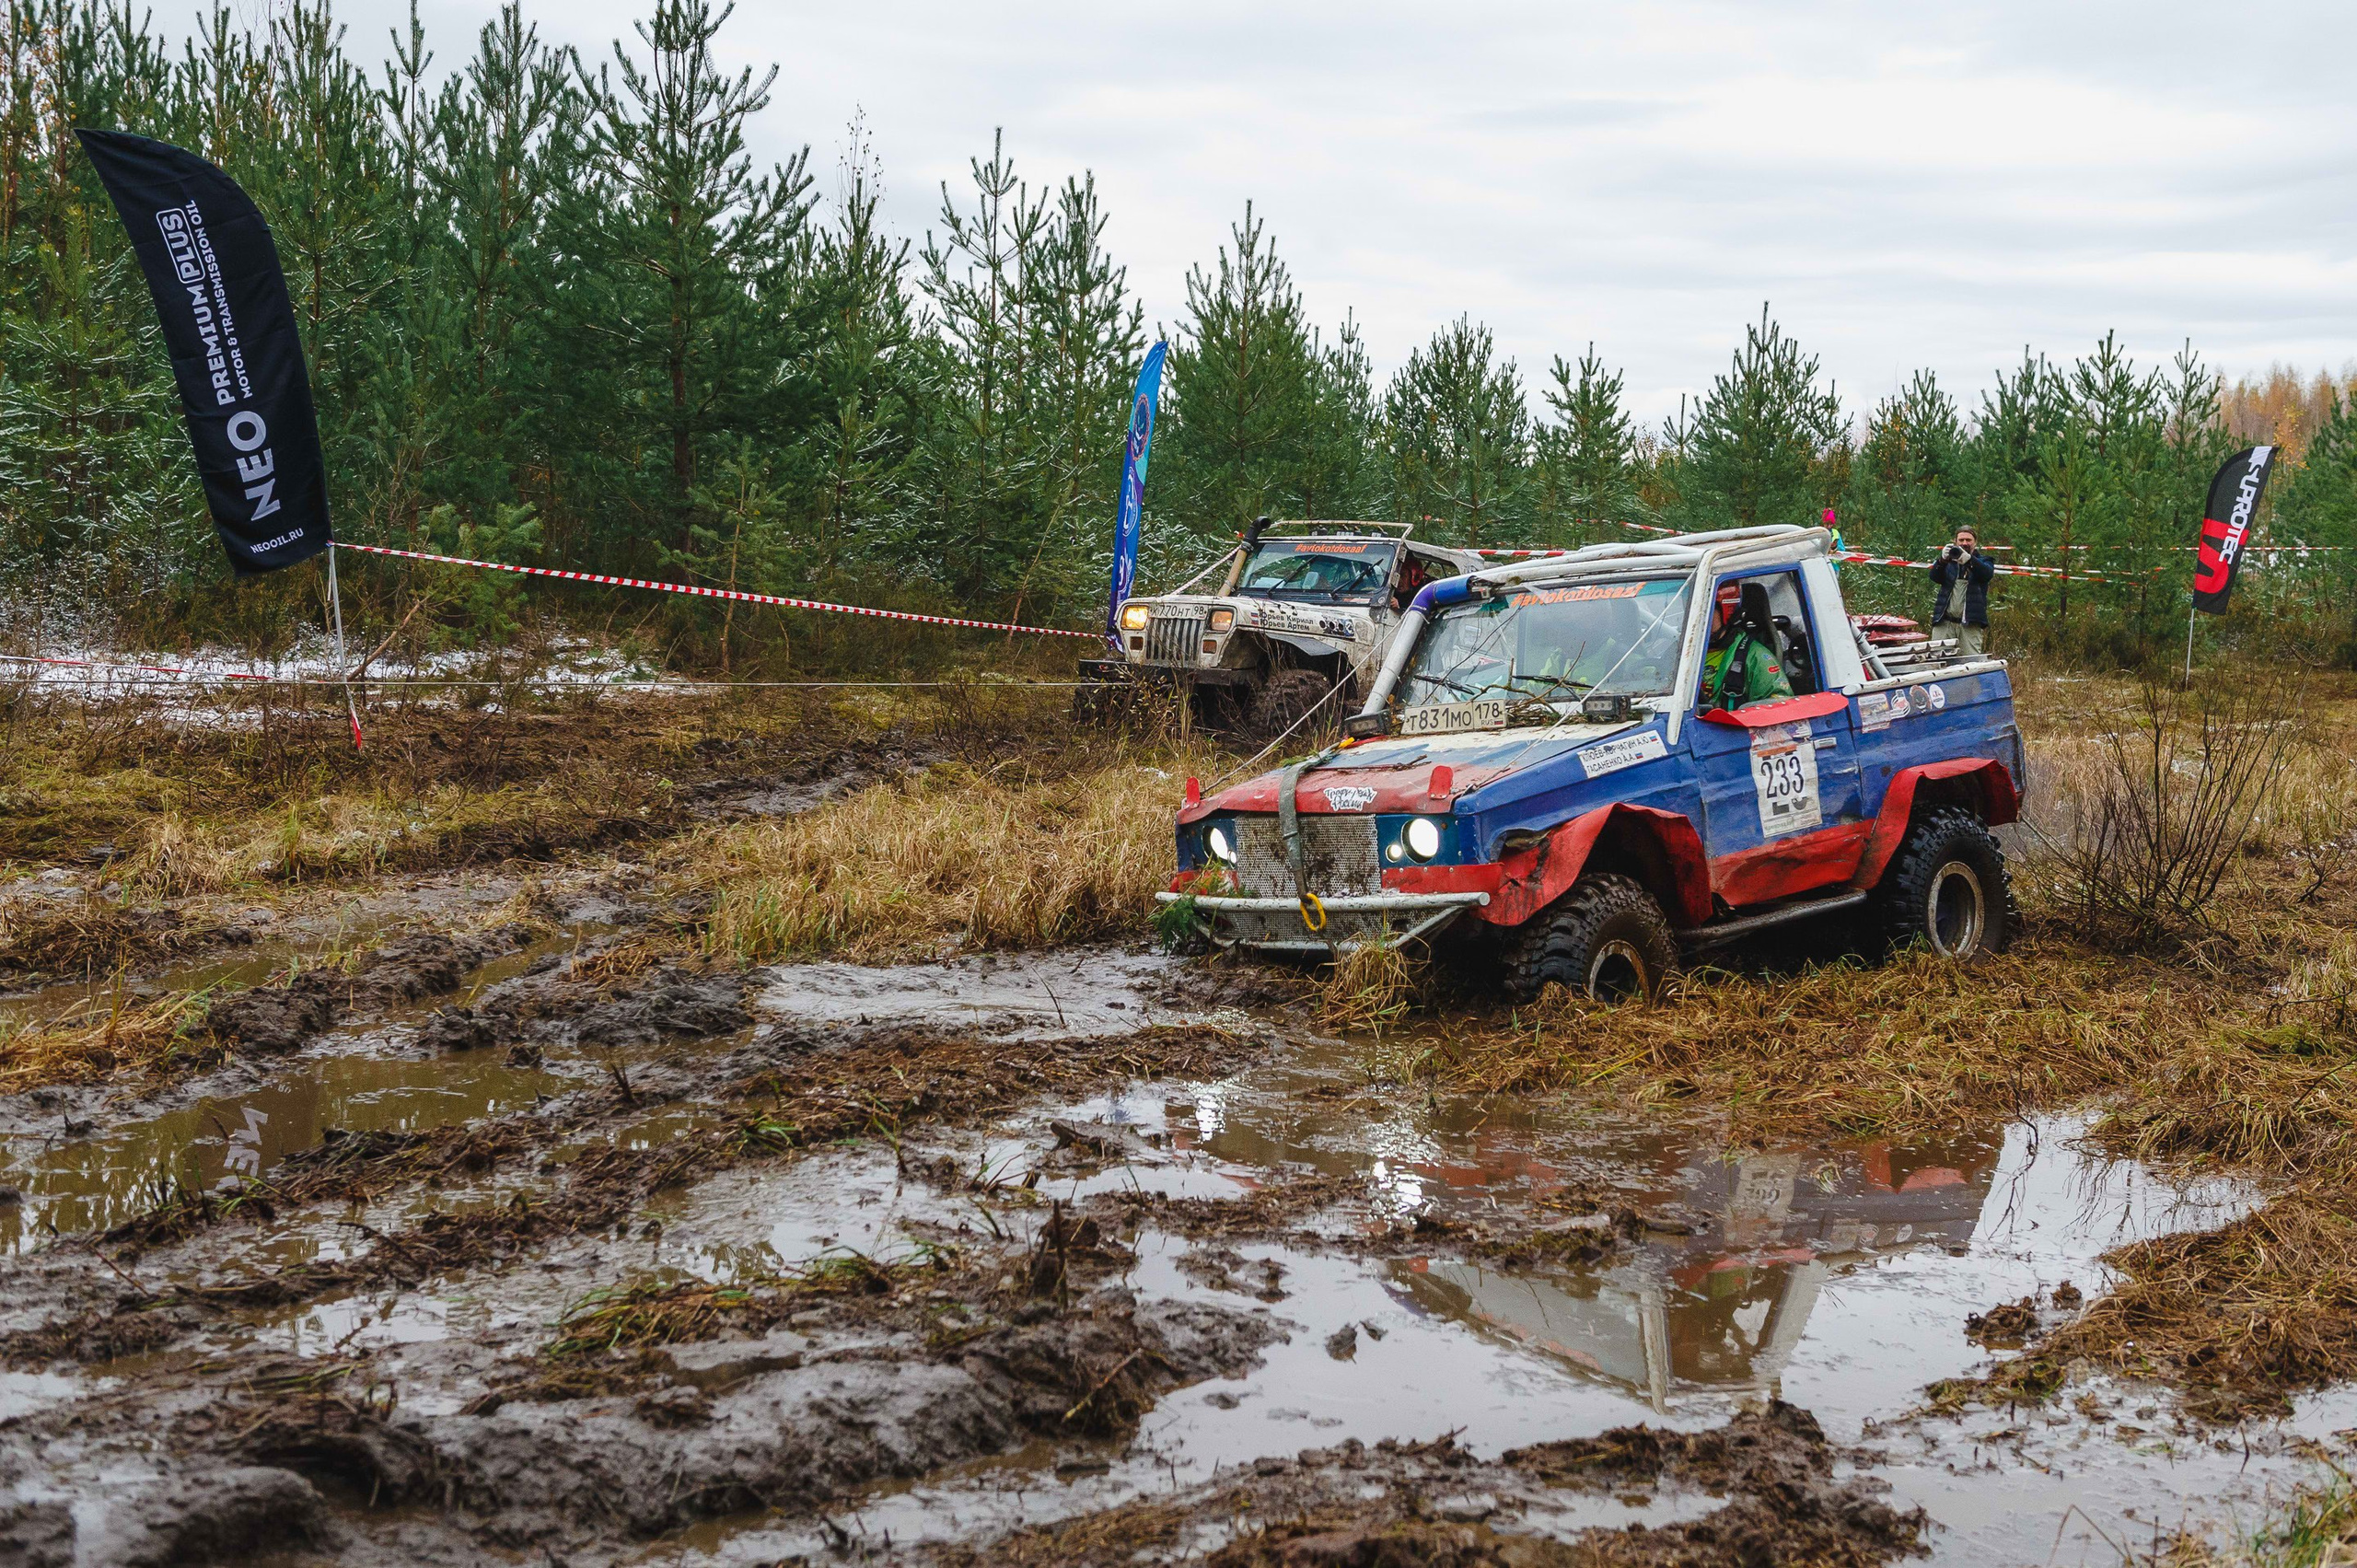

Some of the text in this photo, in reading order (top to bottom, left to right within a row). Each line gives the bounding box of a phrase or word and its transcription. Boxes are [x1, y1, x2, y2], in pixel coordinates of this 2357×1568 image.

[162, 214, 236, 405] PREMIUM PLUS
[185, 200, 253, 399] MOTOR & TRANSMISSION OIL
[226, 411, 281, 521] NEO
[2219, 447, 2272, 564] SUPROTEC
[250, 528, 304, 553] NEOOIL.RU
[1295, 542, 1368, 552] #avtokotdosaaf
[1194, 606, 1203, 615] 98
[1259, 611, 1314, 624] Юрьев Кирилл
[1260, 618, 1310, 632] Юрьев Артем
[1475, 703, 1500, 719] 178
[1760, 756, 1804, 798] 233
